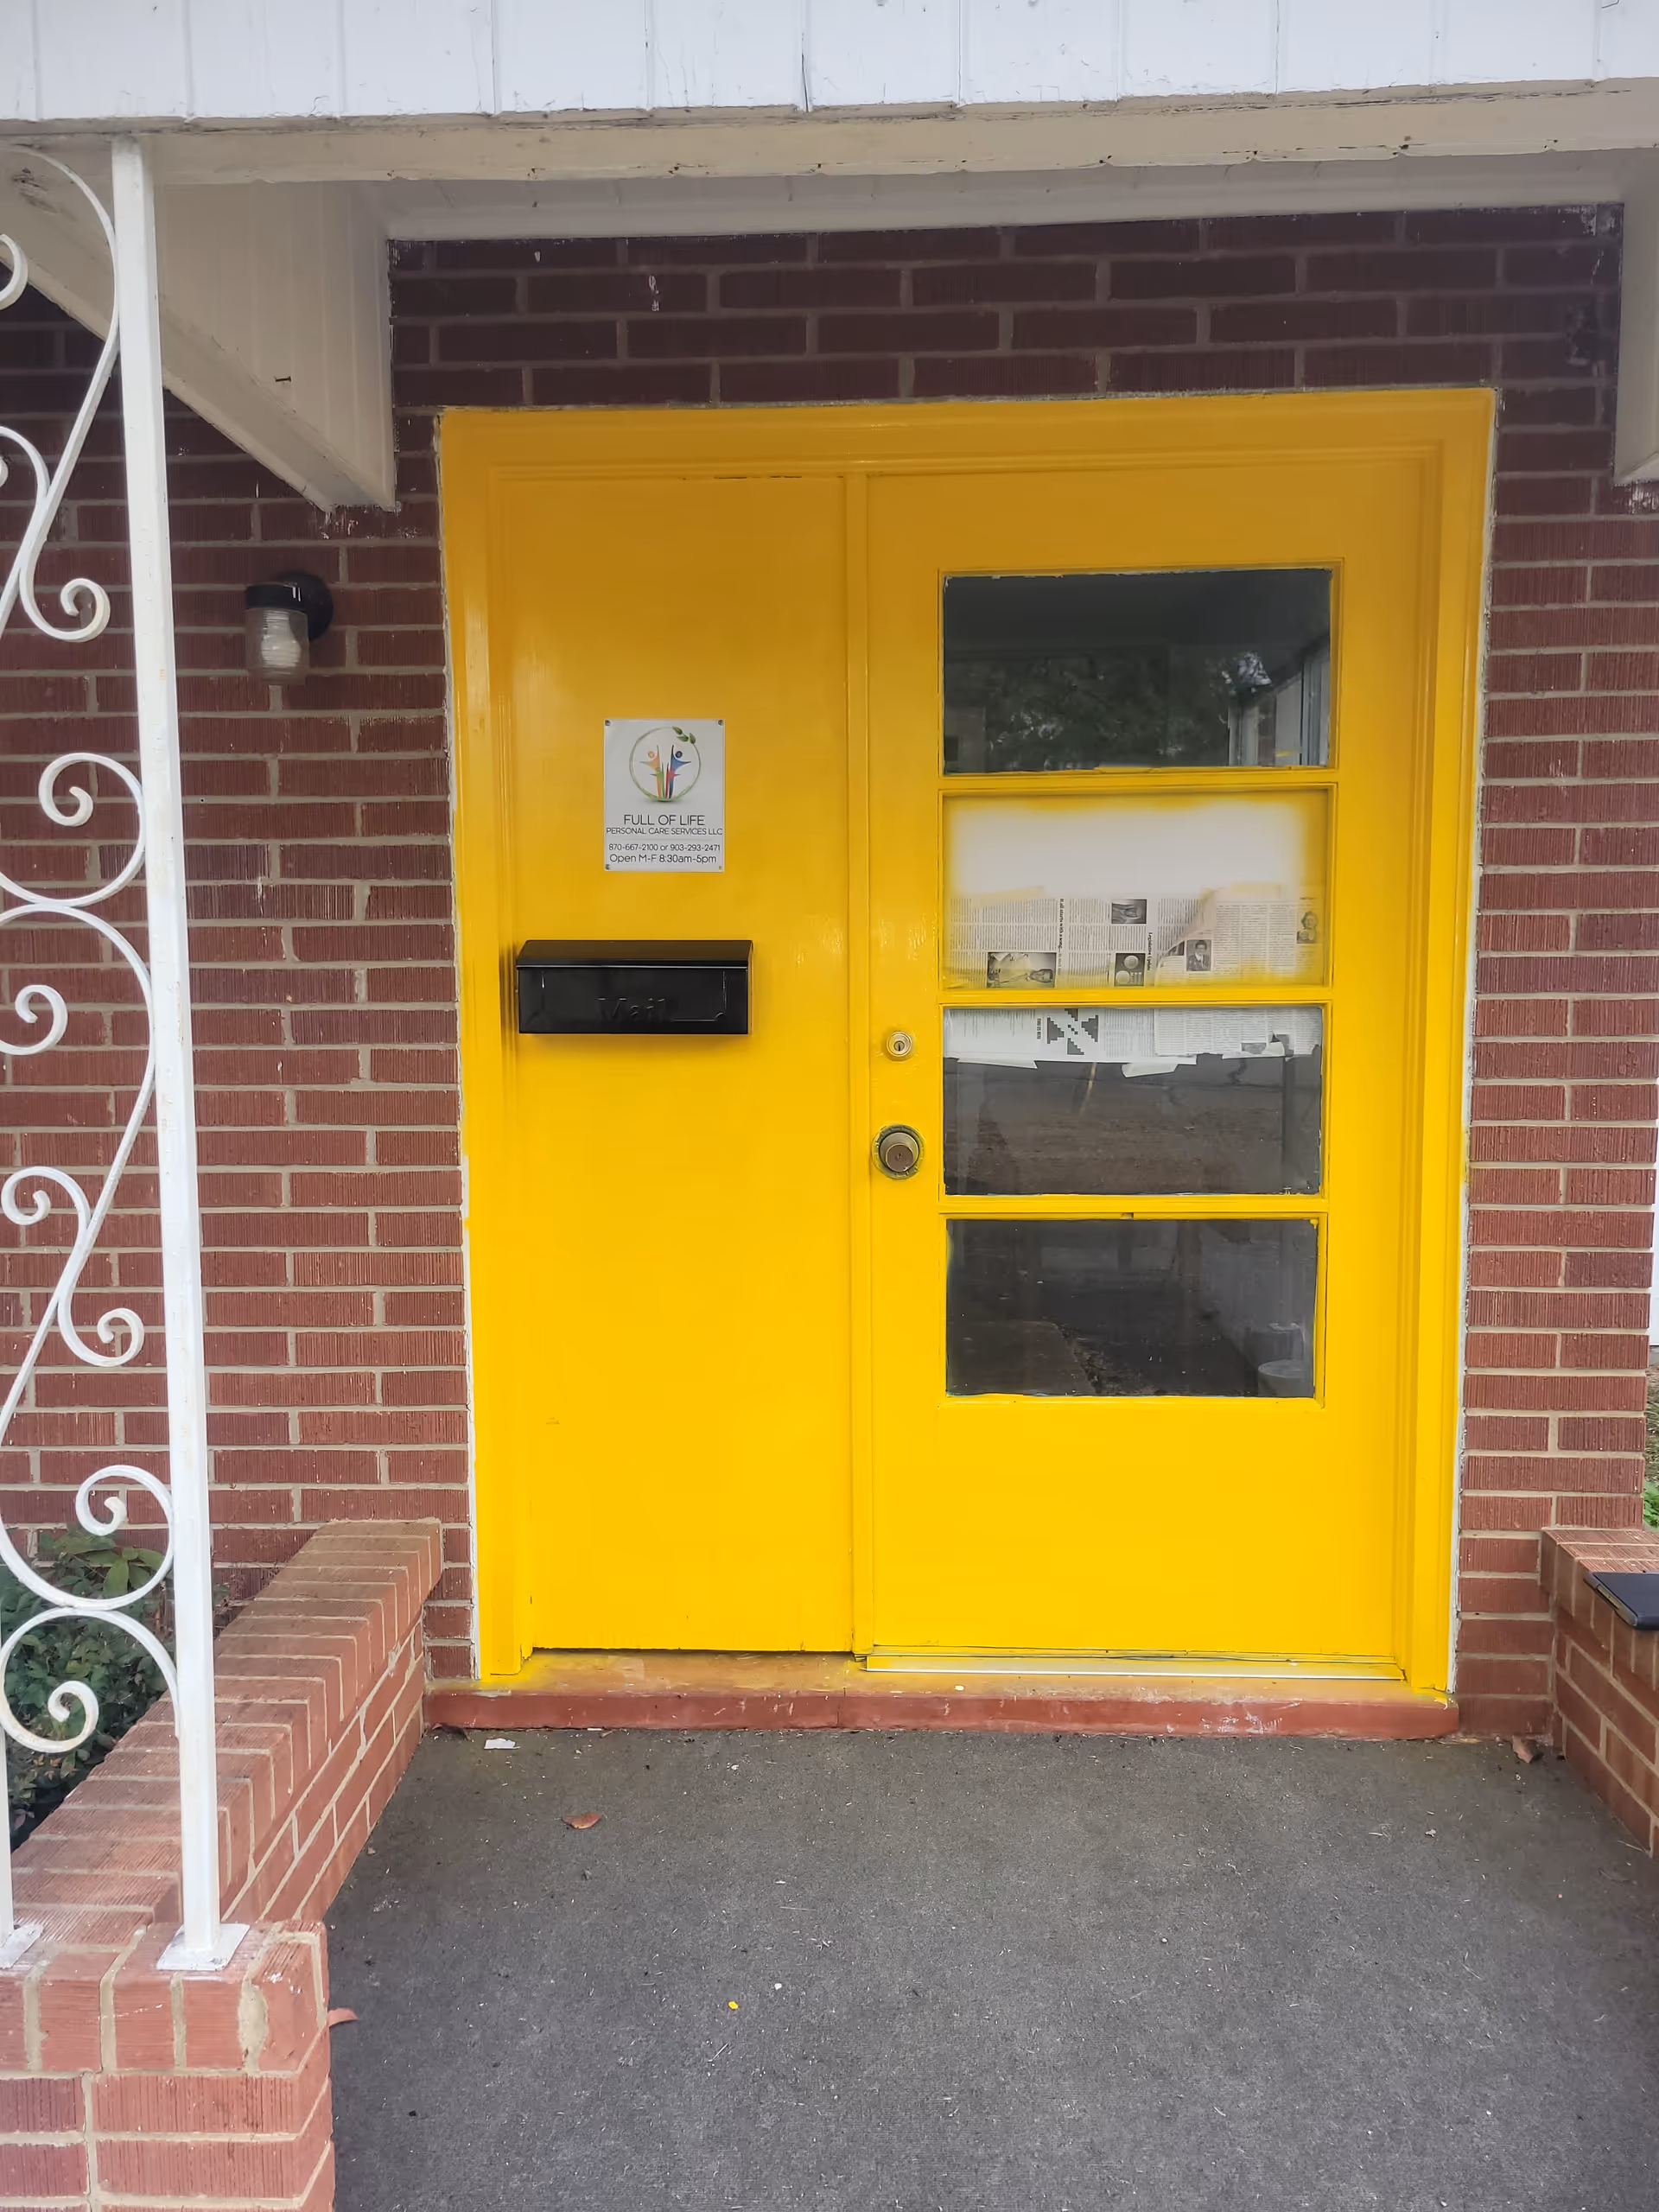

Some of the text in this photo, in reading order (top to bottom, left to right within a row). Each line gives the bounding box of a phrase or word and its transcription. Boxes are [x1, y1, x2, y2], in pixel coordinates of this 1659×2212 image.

[623, 815, 706, 826] FULL OF LIFE
[608, 843, 658, 852] 870-667-2100
[670, 843, 721, 852] 903-293-2471
[609, 854, 717, 865] Open M-F 8:30am-5pm
